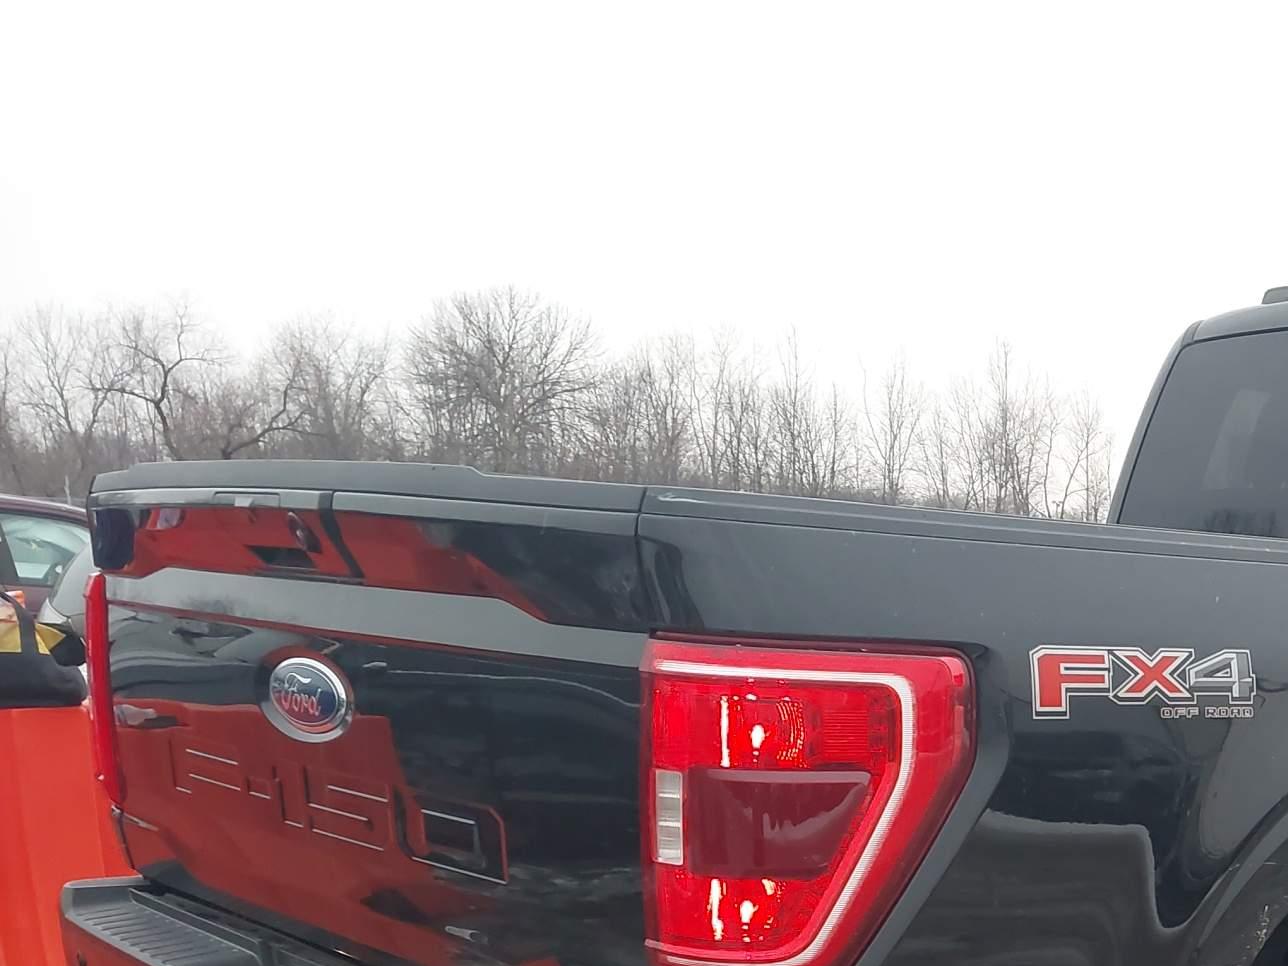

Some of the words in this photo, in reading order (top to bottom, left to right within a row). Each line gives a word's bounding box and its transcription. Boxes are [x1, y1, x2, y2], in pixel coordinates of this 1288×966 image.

[280, 672, 321, 716] Ford
[1029, 645, 1257, 719] FX4
[1160, 705, 1199, 719] OFF
[1204, 706, 1255, 719] ROAD
[169, 736, 510, 885] F-150
